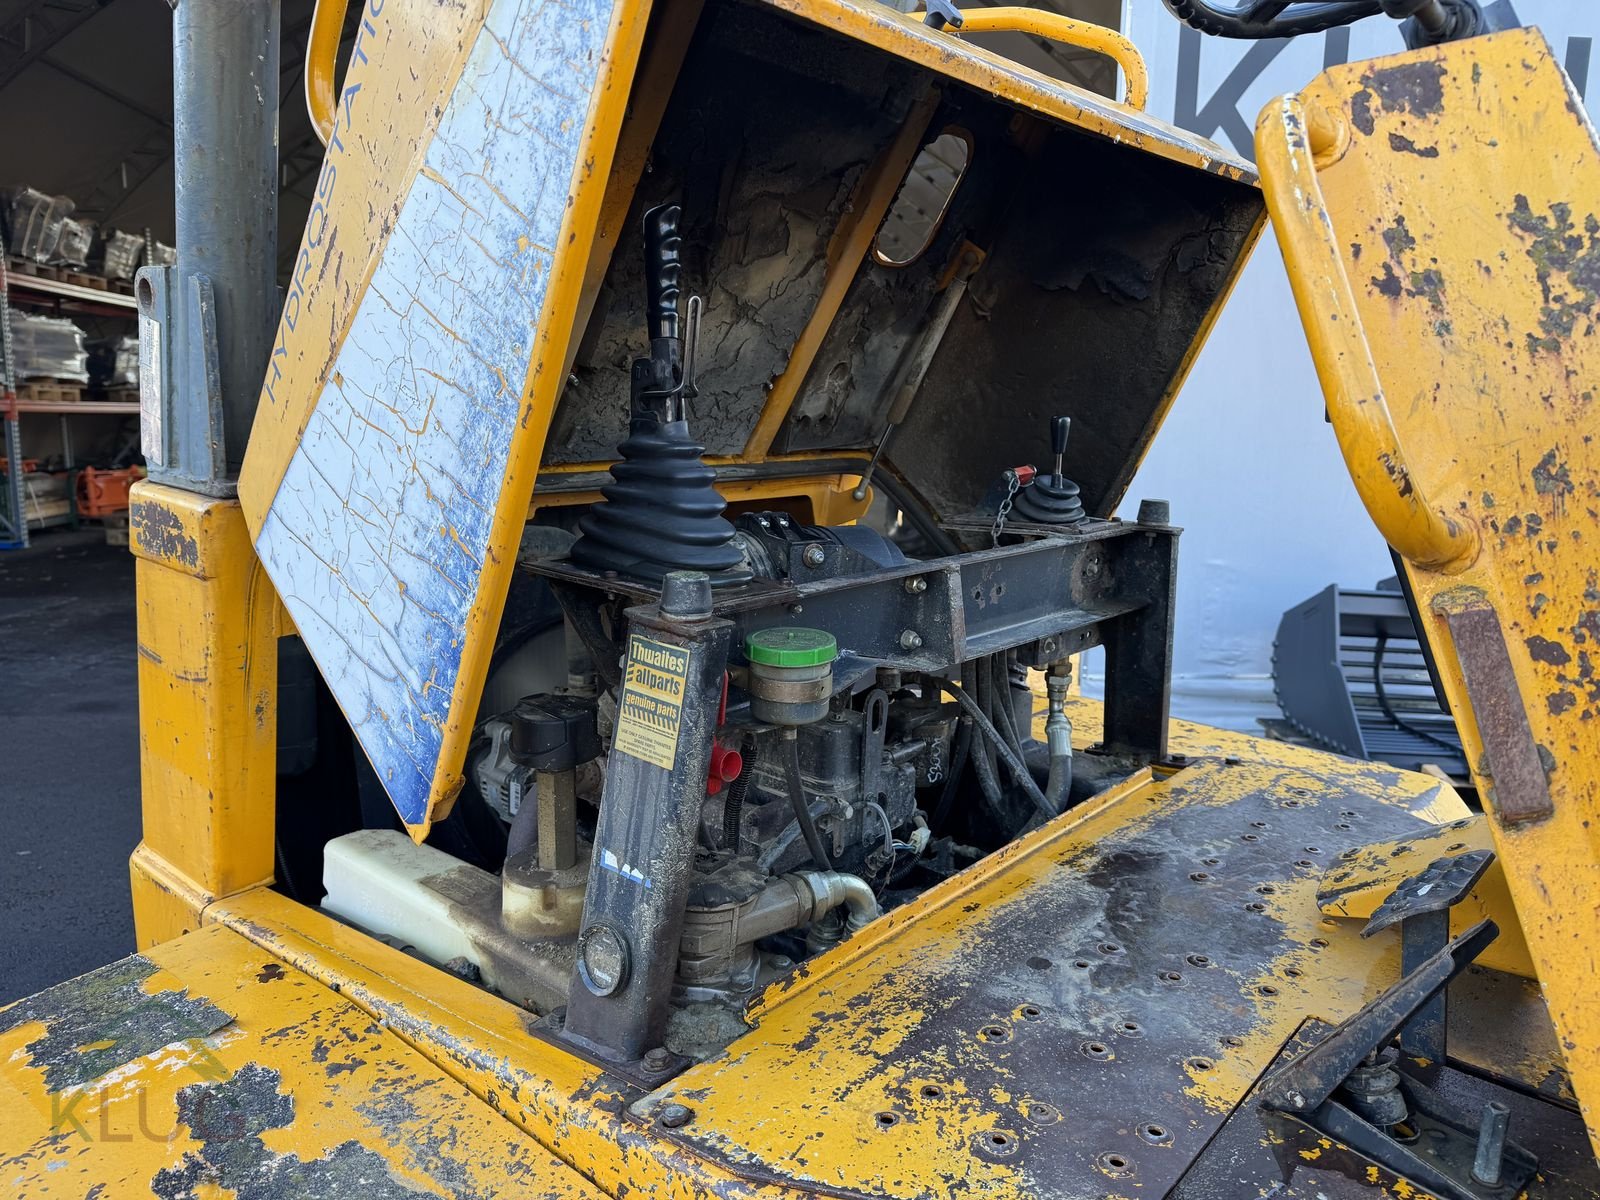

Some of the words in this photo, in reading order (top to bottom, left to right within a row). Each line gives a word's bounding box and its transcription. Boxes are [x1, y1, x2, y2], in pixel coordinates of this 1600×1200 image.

[632, 641, 684, 673] Thwaites
[636, 668, 680, 696] allparts
[626, 692, 656, 711] genuine
[656, 703, 677, 719] parts
